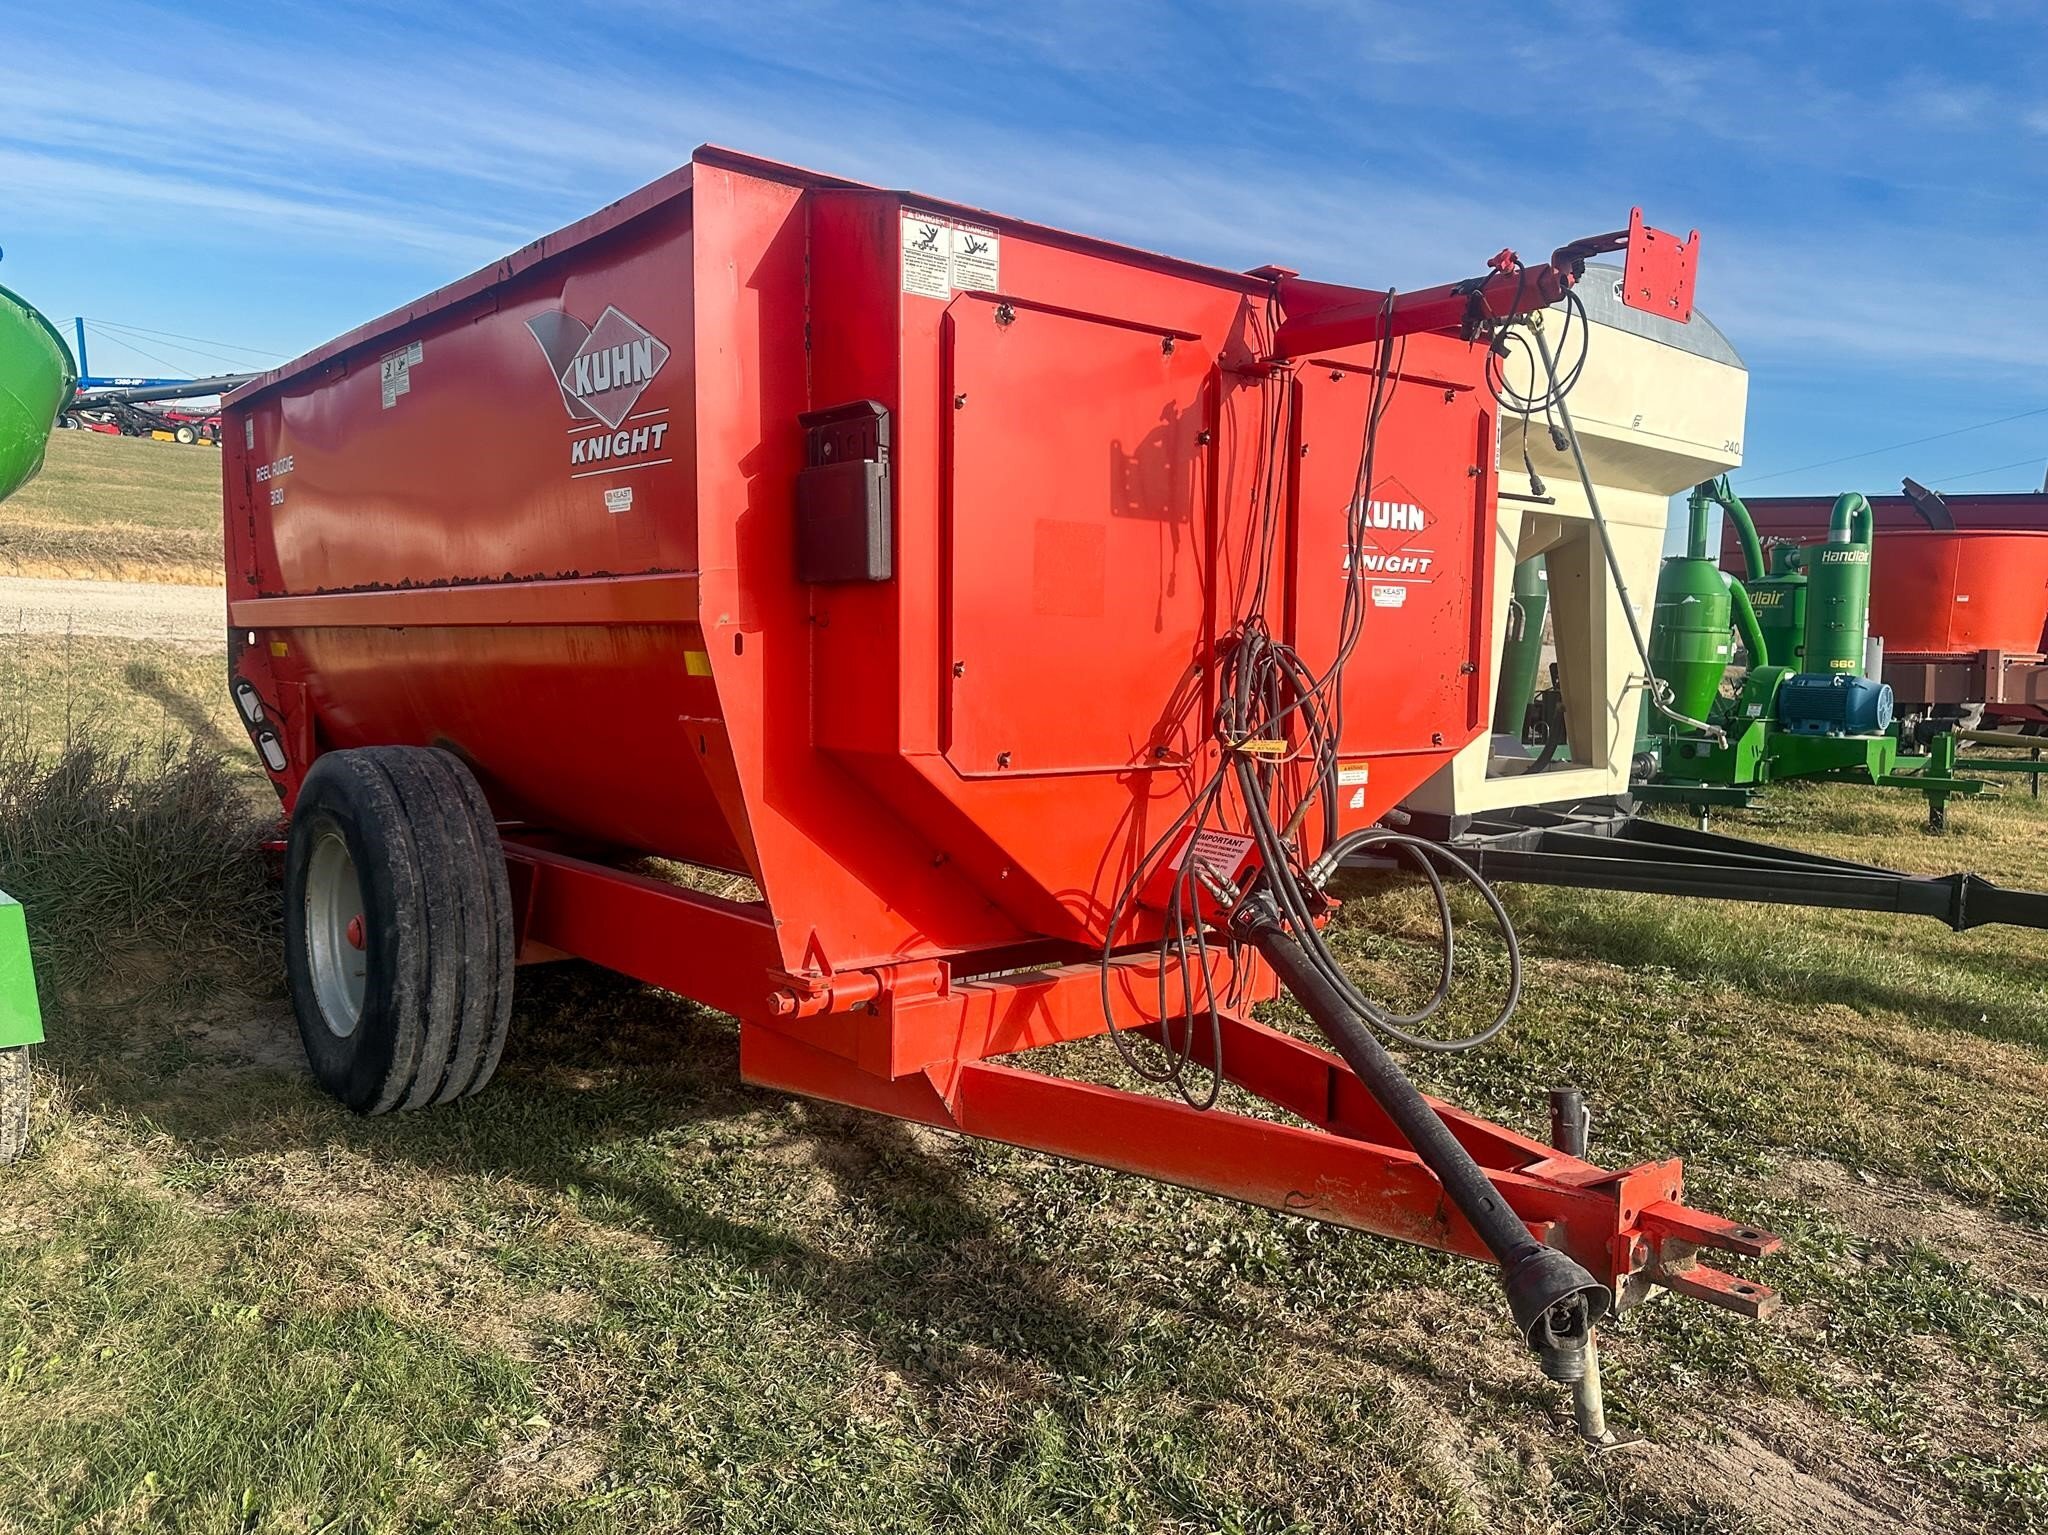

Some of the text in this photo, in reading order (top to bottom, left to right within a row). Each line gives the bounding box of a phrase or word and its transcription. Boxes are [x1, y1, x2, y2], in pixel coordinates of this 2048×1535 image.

[965, 223, 994, 238] DANGER
[573, 336, 653, 398] KUHN
[570, 421, 668, 466] KNIGHT
[1723, 440, 1740, 455] 240
[256, 464, 271, 482] REEL
[1821, 549, 1870, 562] Handlair
[1382, 587, 1405, 596] KEAST
[1829, 660, 1856, 669] 660
[1198, 833, 1244, 847] IMPORTANT
